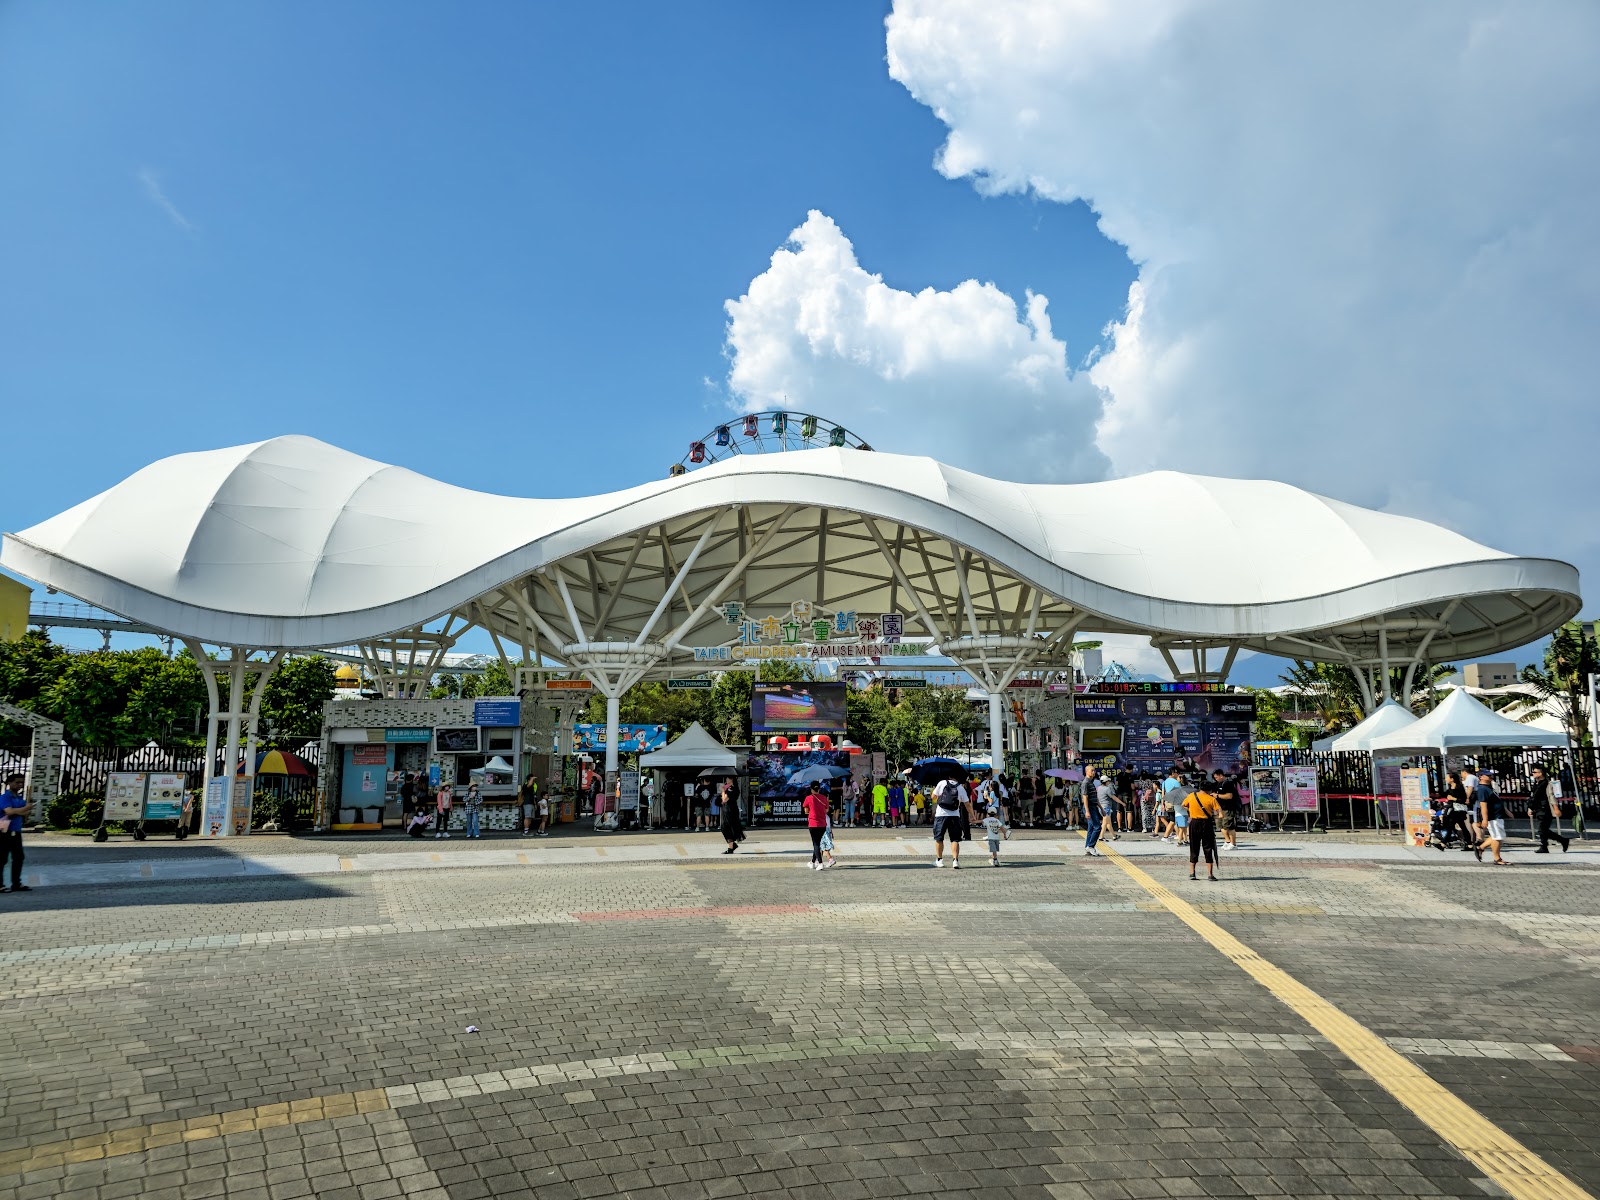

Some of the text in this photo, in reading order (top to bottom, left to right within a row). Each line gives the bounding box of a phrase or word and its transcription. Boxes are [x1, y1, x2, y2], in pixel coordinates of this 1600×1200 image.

[694, 643, 928, 660] TAIPEI CHILDREN'S AMUSEMENT PARK
[672, 680, 685, 688] 入口
[887, 679, 900, 687] 入口
[1146, 699, 1186, 711] 售票處
